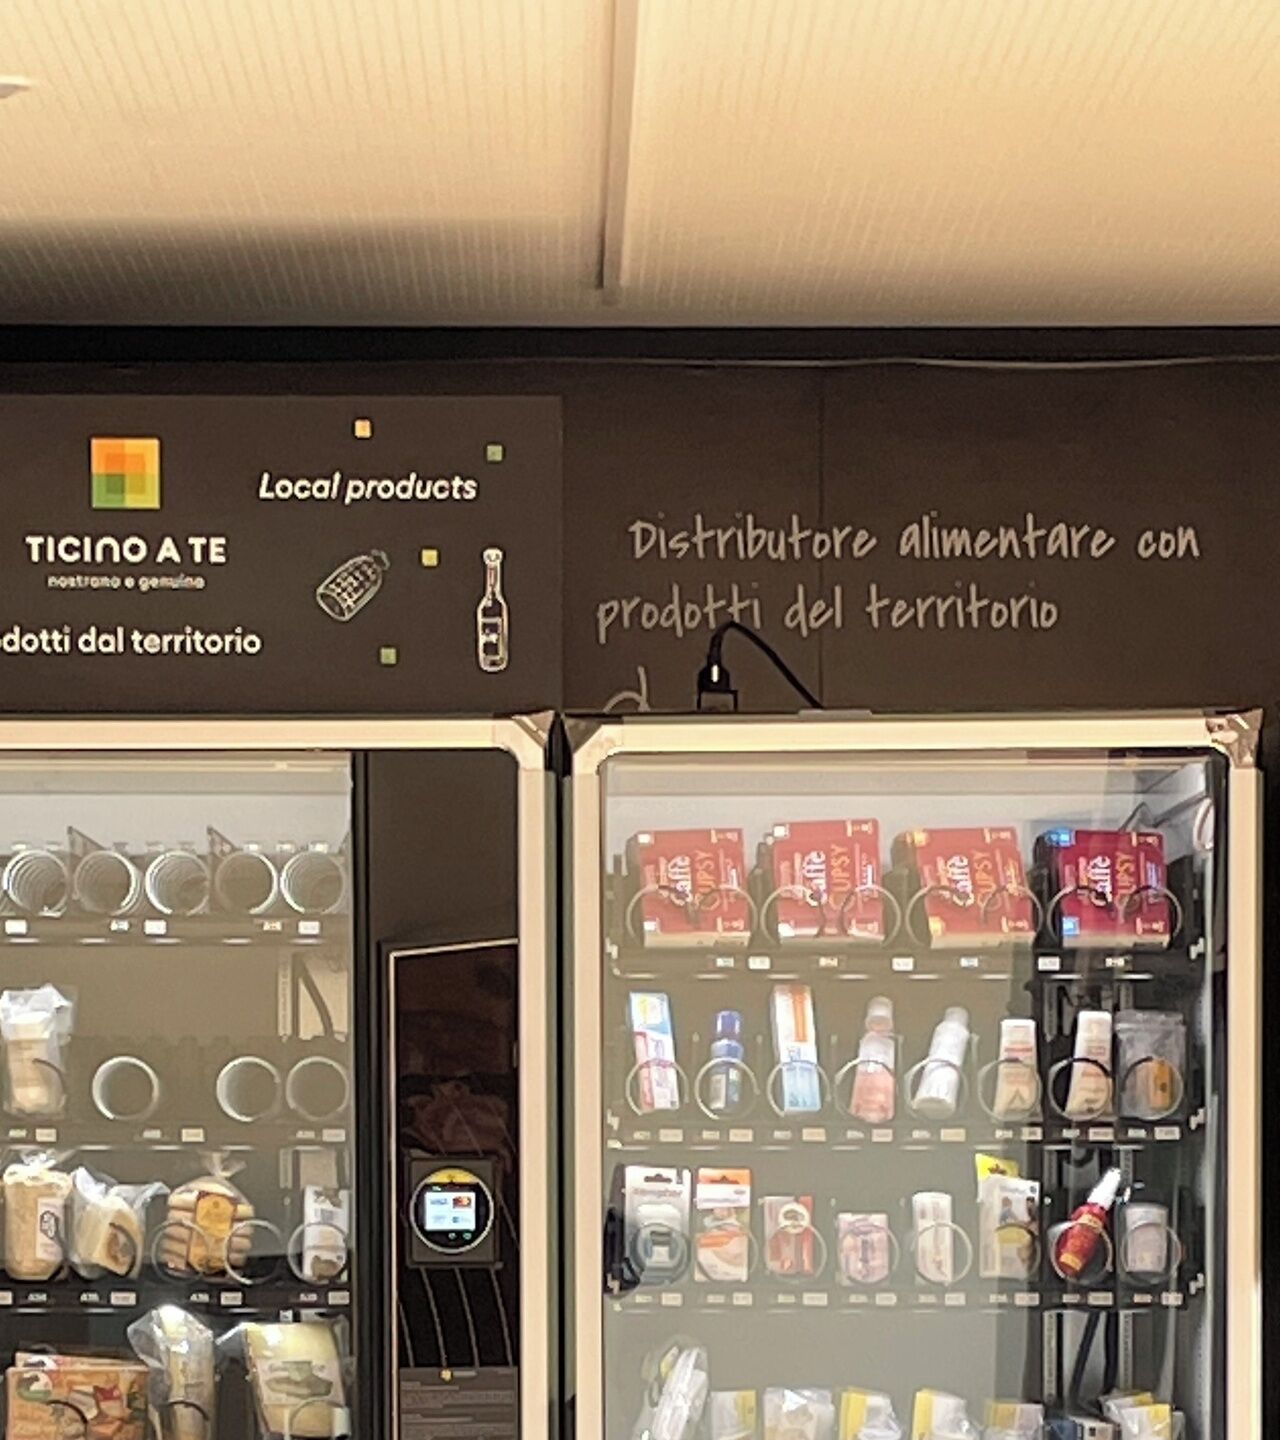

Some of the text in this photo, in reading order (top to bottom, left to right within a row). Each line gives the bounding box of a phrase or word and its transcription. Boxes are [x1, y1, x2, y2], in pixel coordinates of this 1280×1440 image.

[259, 471, 478, 505] Local products
[25, 535, 227, 563] TICINO A TE
[628, 511, 1200, 561] Distributore alimentare con
[597, 582, 1058, 644] prodotti del territorio
[77, 625, 124, 654] dal
[130, 625, 262, 655] territorio
